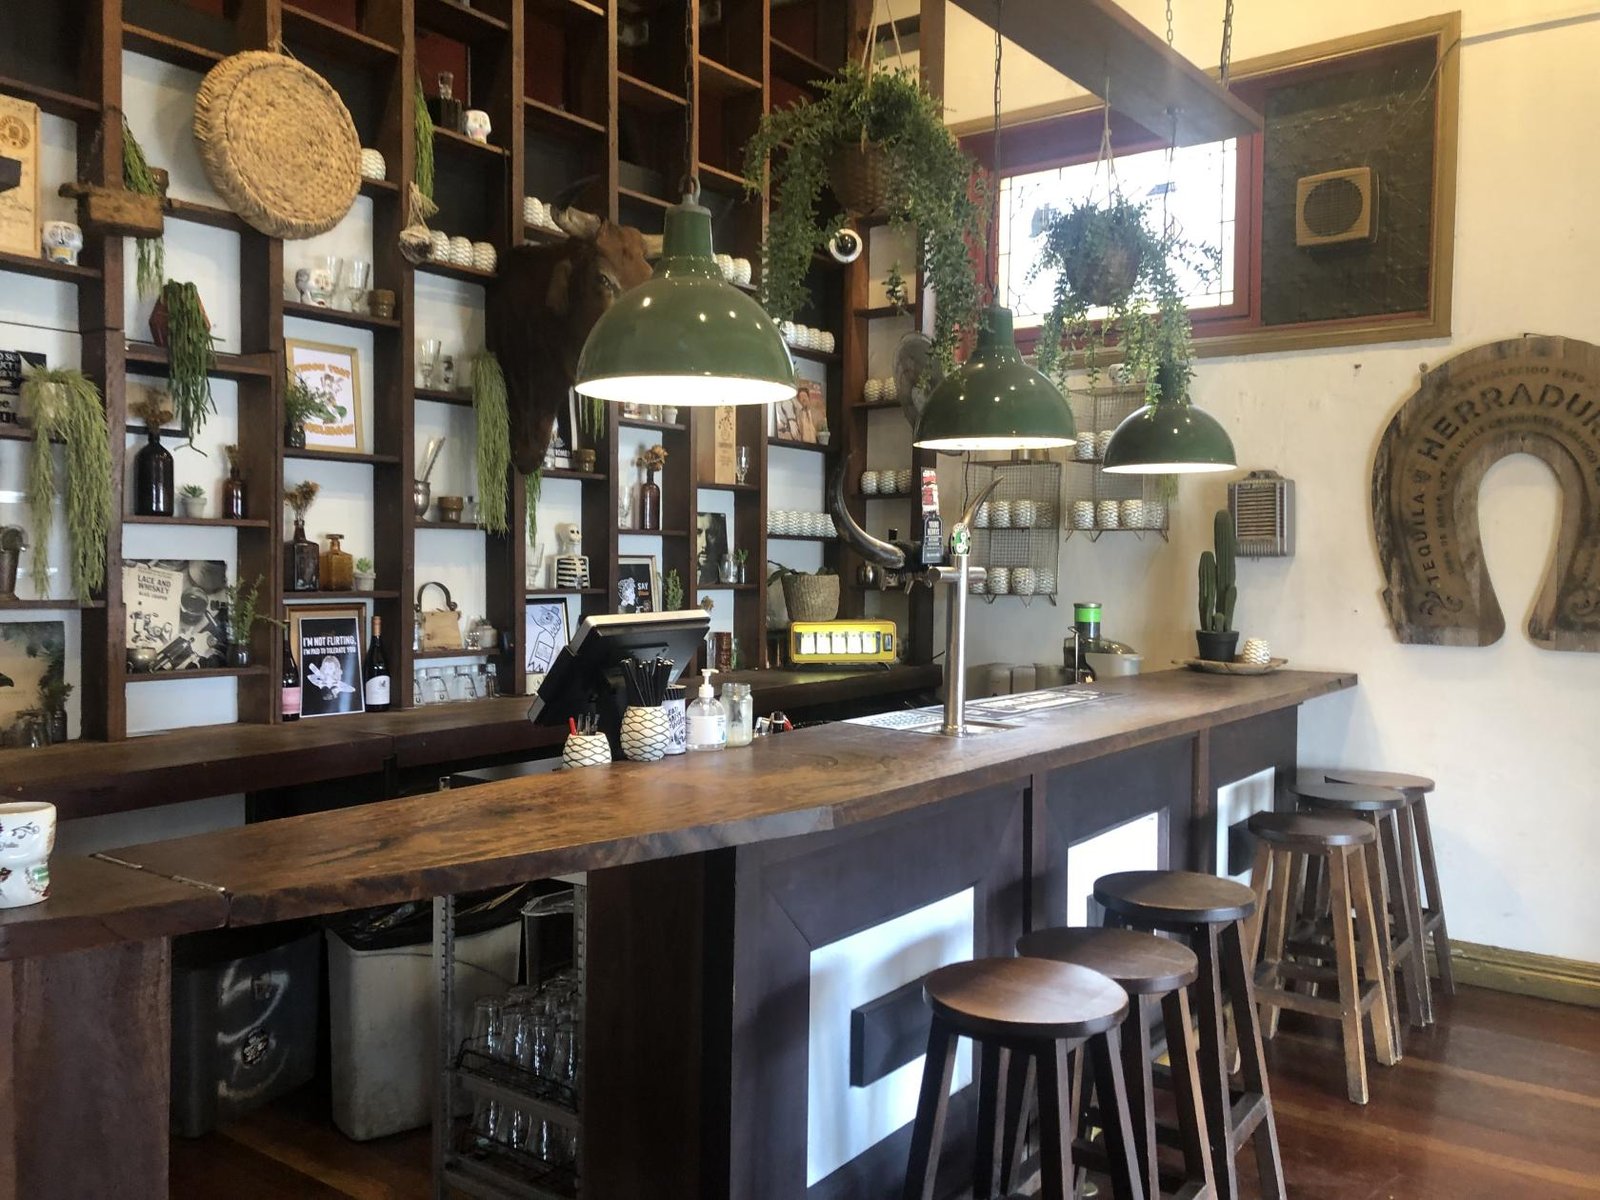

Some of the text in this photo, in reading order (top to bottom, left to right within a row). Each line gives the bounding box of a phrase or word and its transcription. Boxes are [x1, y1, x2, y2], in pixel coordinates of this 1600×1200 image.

[1411, 493, 1440, 586] TEQUILA
[157, 578, 171, 588] AND
[637, 582, 649, 590] SAY
[303, 637, 313, 648] I'M
[313, 636, 326, 647] NOT
